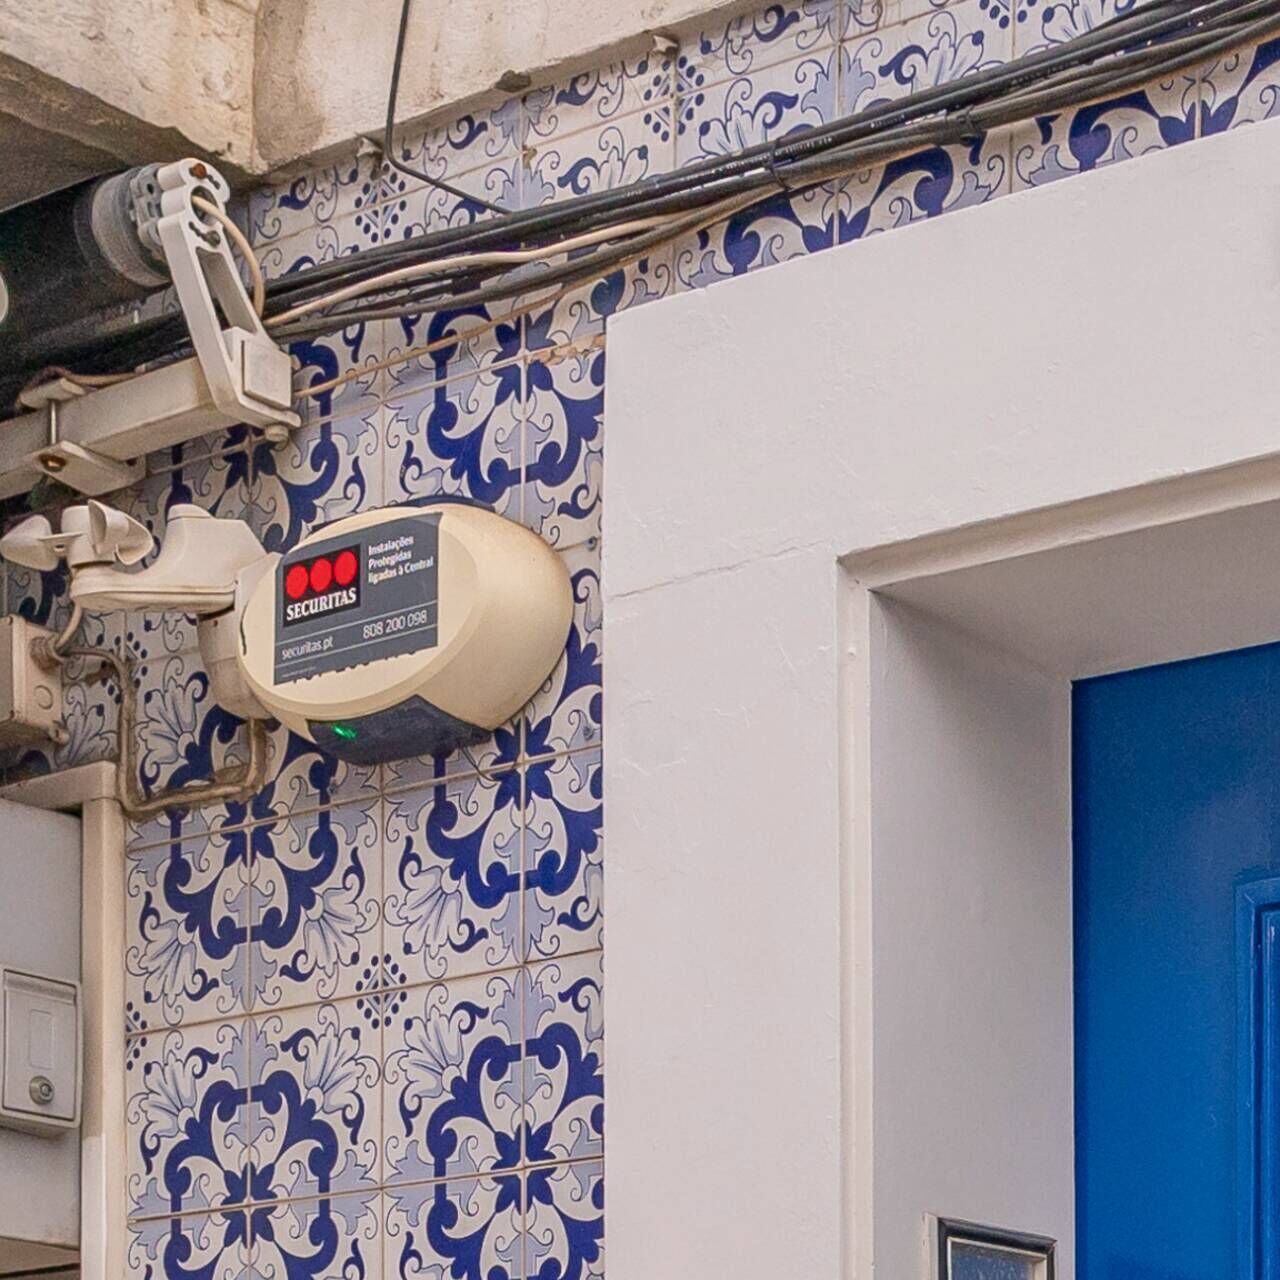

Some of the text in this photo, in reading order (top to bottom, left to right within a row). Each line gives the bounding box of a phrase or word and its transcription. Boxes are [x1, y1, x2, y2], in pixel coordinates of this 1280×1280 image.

[368, 536, 414, 556] Instalações
[368, 550, 412, 570] Protegidas
[404, 555, 434, 574] Central
[286, 587, 357, 621] SECURITAS
[282, 610, 428, 660] securitas.pt 808 200 098
